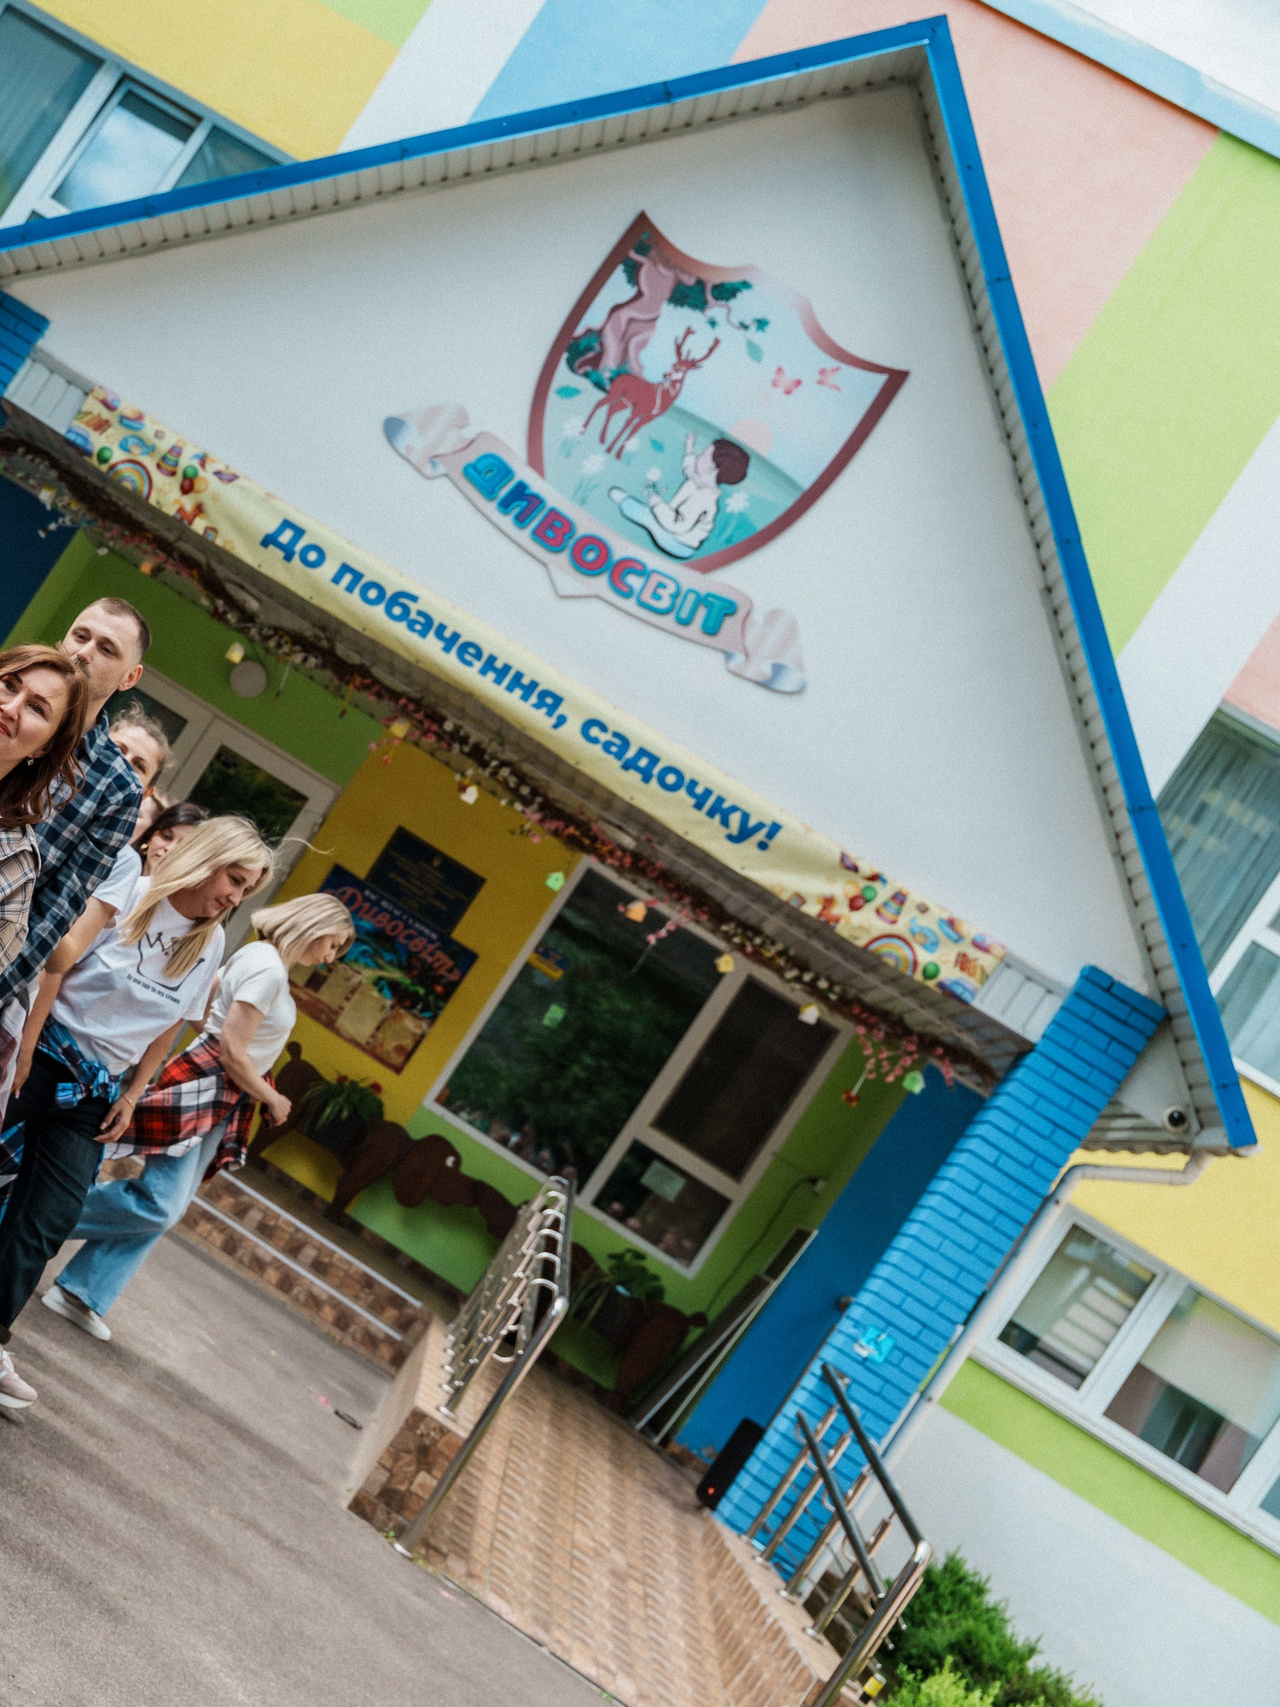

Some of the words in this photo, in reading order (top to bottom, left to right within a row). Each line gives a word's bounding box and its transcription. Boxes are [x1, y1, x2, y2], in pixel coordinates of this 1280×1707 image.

[462, 453, 737, 635] ДИВОСВІТ
[261, 519, 326, 569] До
[331, 562, 567, 729] побачення,
[580, 718, 782, 851] садочку!
